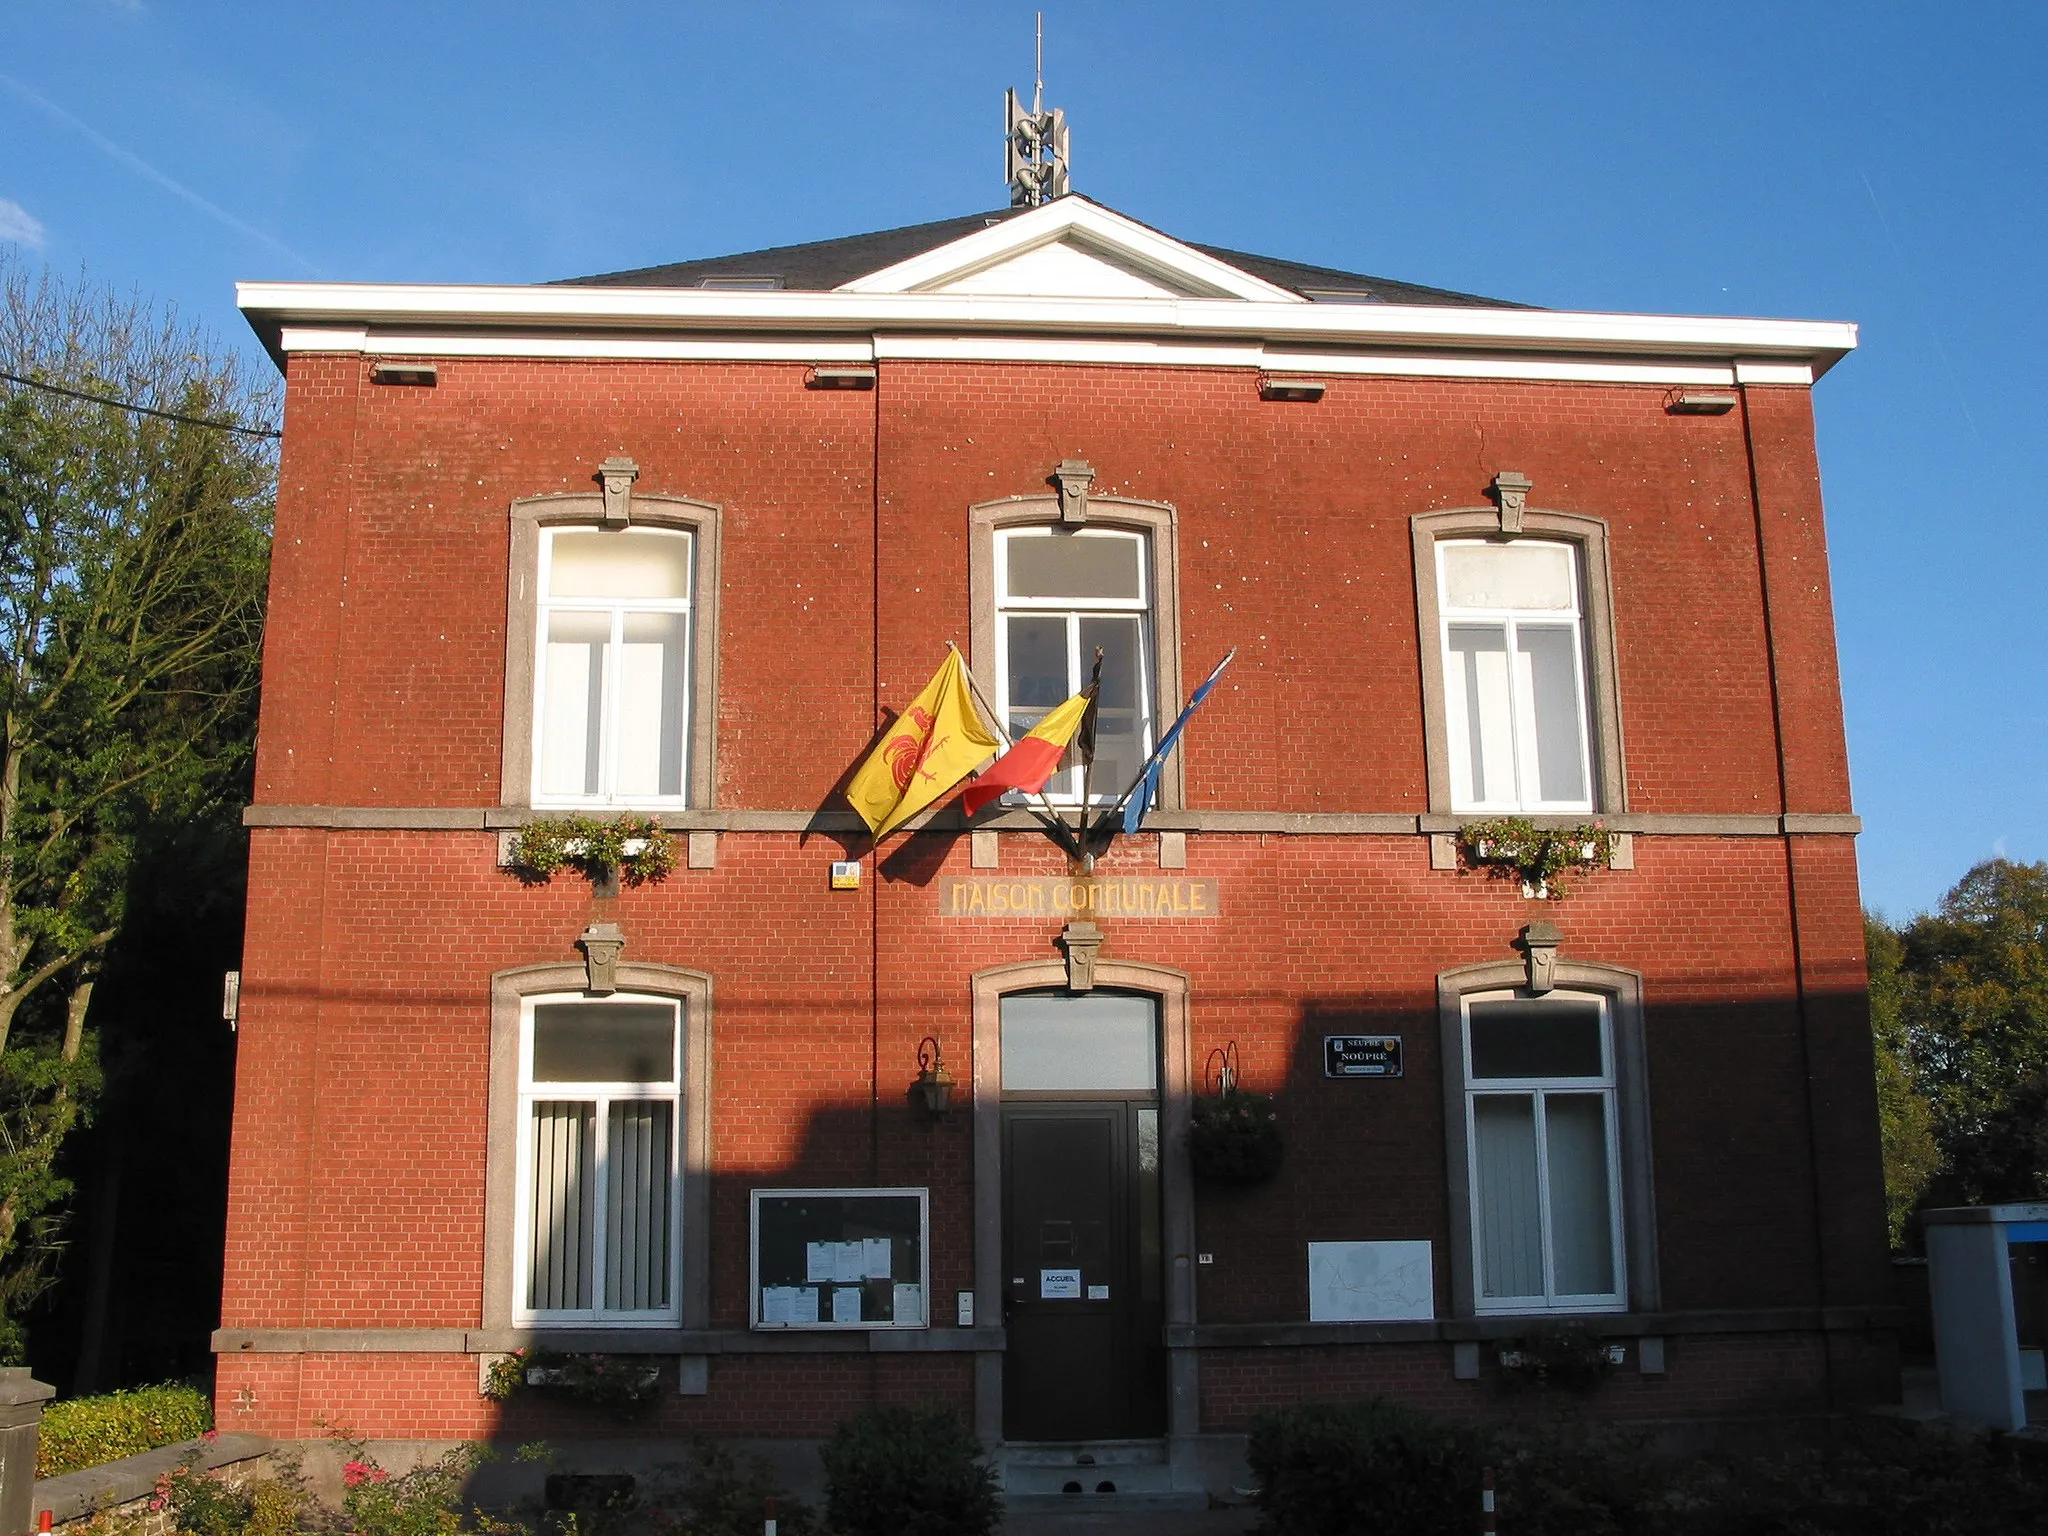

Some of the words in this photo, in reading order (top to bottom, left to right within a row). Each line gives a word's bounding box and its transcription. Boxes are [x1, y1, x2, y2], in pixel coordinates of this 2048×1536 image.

[951, 883, 1044, 911] MAISON
[1052, 883, 1206, 911] COMMUNALE
[1045, 1275, 1076, 1283] ACCUEIL
